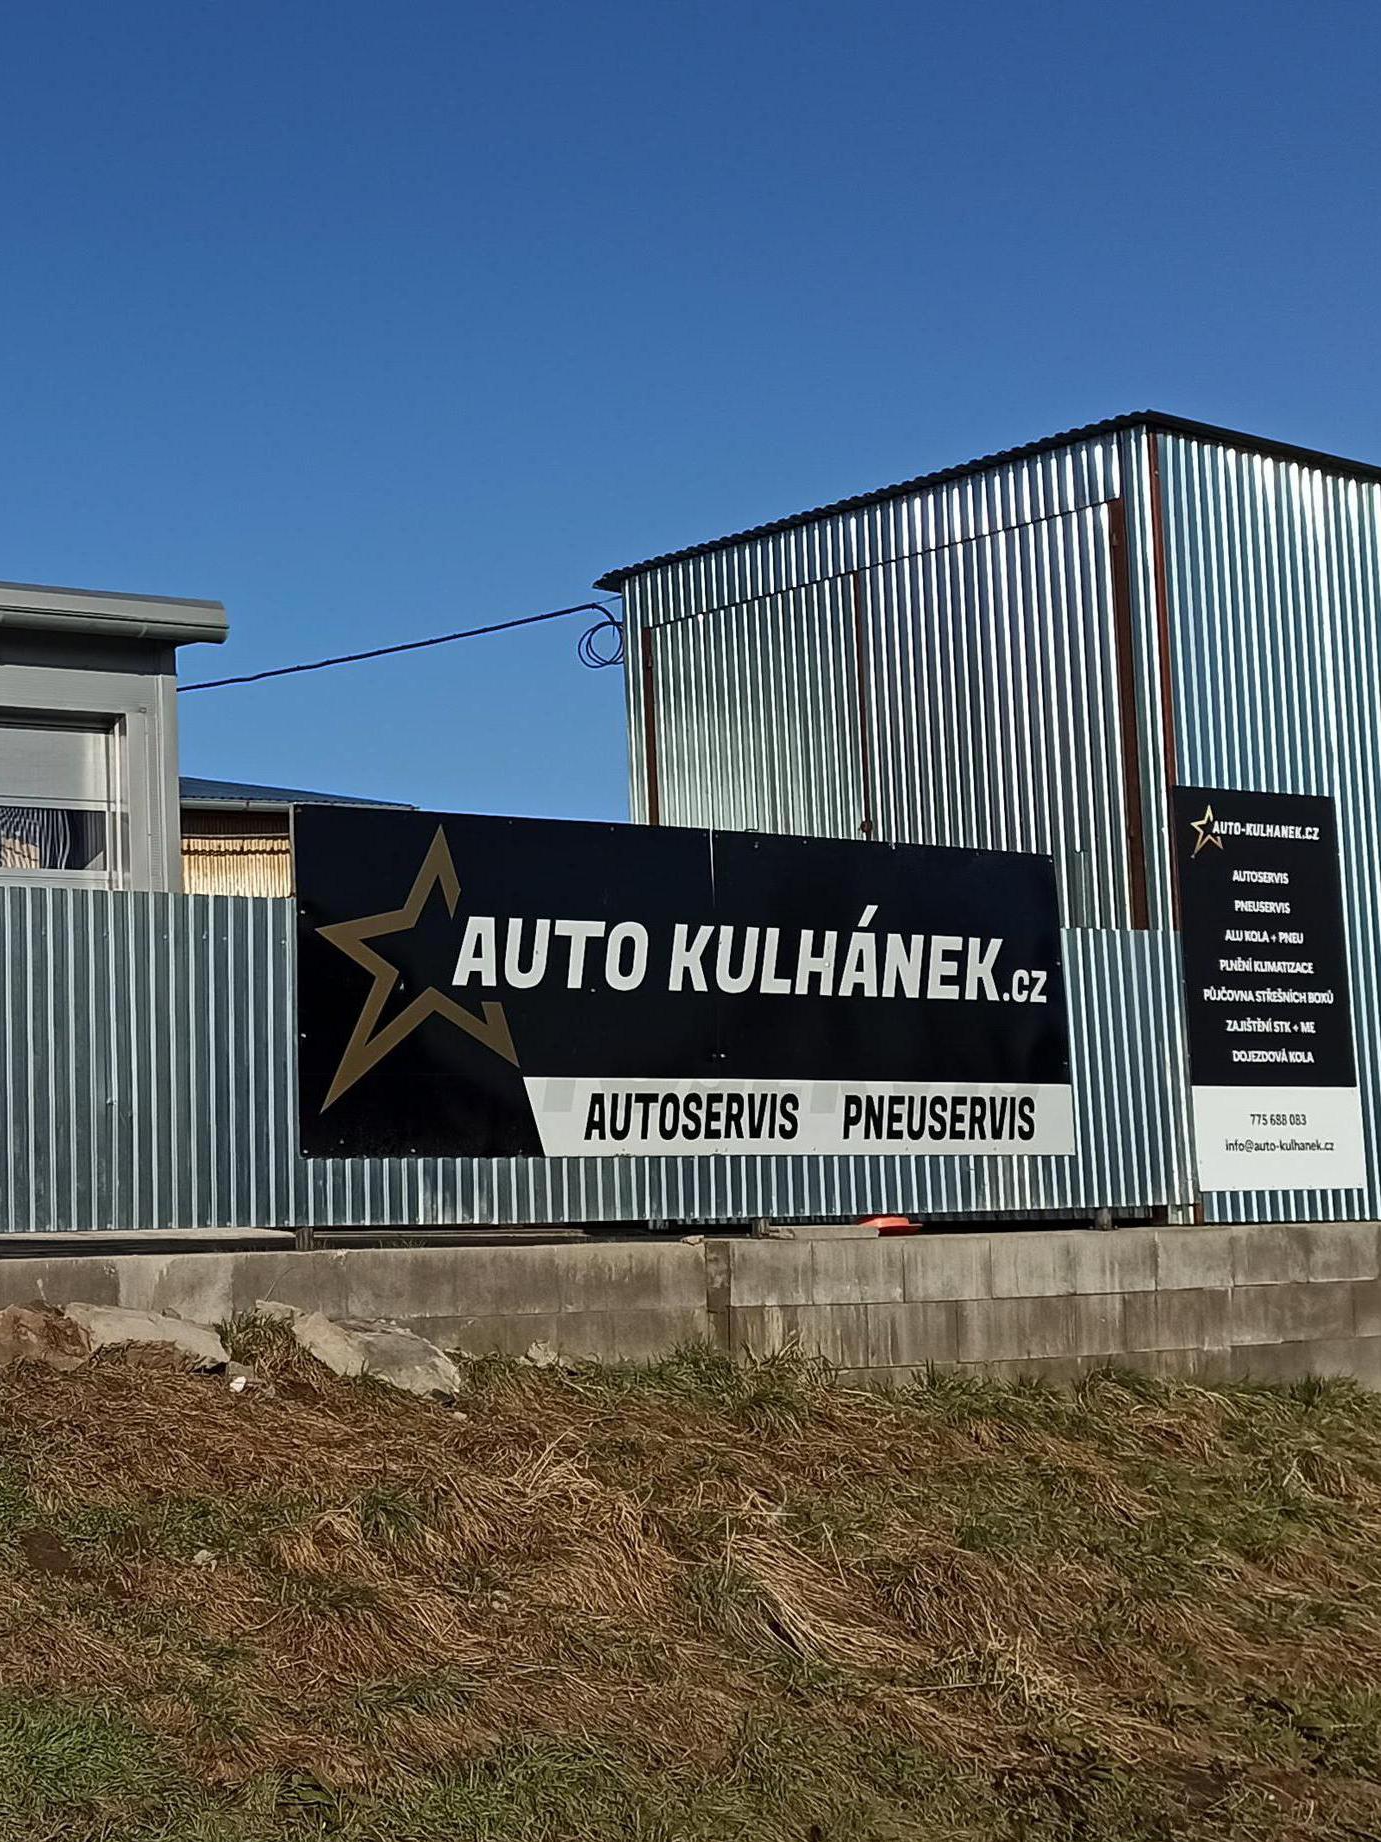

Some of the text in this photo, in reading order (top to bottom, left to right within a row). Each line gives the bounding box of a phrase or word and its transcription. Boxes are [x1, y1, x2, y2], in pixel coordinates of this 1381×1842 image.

[1212, 820, 1320, 841] AUTO-KULHANEK.CZ
[1232, 869, 1290, 885] AUTOSERVIS
[1234, 899, 1291, 914] PNEUSERVIS
[1225, 929, 1304, 944] ALU KOLA + PNEU
[451, 916, 649, 992] AUTO
[1219, 957, 1315, 974] PLNĚNÍ KLIMATIZACE
[1203, 986, 1255, 1003] PŮJČOVNA
[1255, 987, 1307, 1003] STŘEŠNÍCH
[1226, 1017, 1273, 1032] ZAJIŠTĚNÍ
[1273, 1021, 1292, 1033] STK
[1300, 1021, 1316, 1034] ME
[1232, 1048, 1315, 1063] DOJEZDOVÁ KOLA
[583, 1092, 800, 1141] AUTOSERVIS
[843, 1094, 1035, 1141] PNEUSERVIS
[1250, 1113, 1268, 1126] 775
[1289, 1113, 1307, 1126] 083
[1225, 1139, 1335, 1153] info@auto-kulhanek.cz
